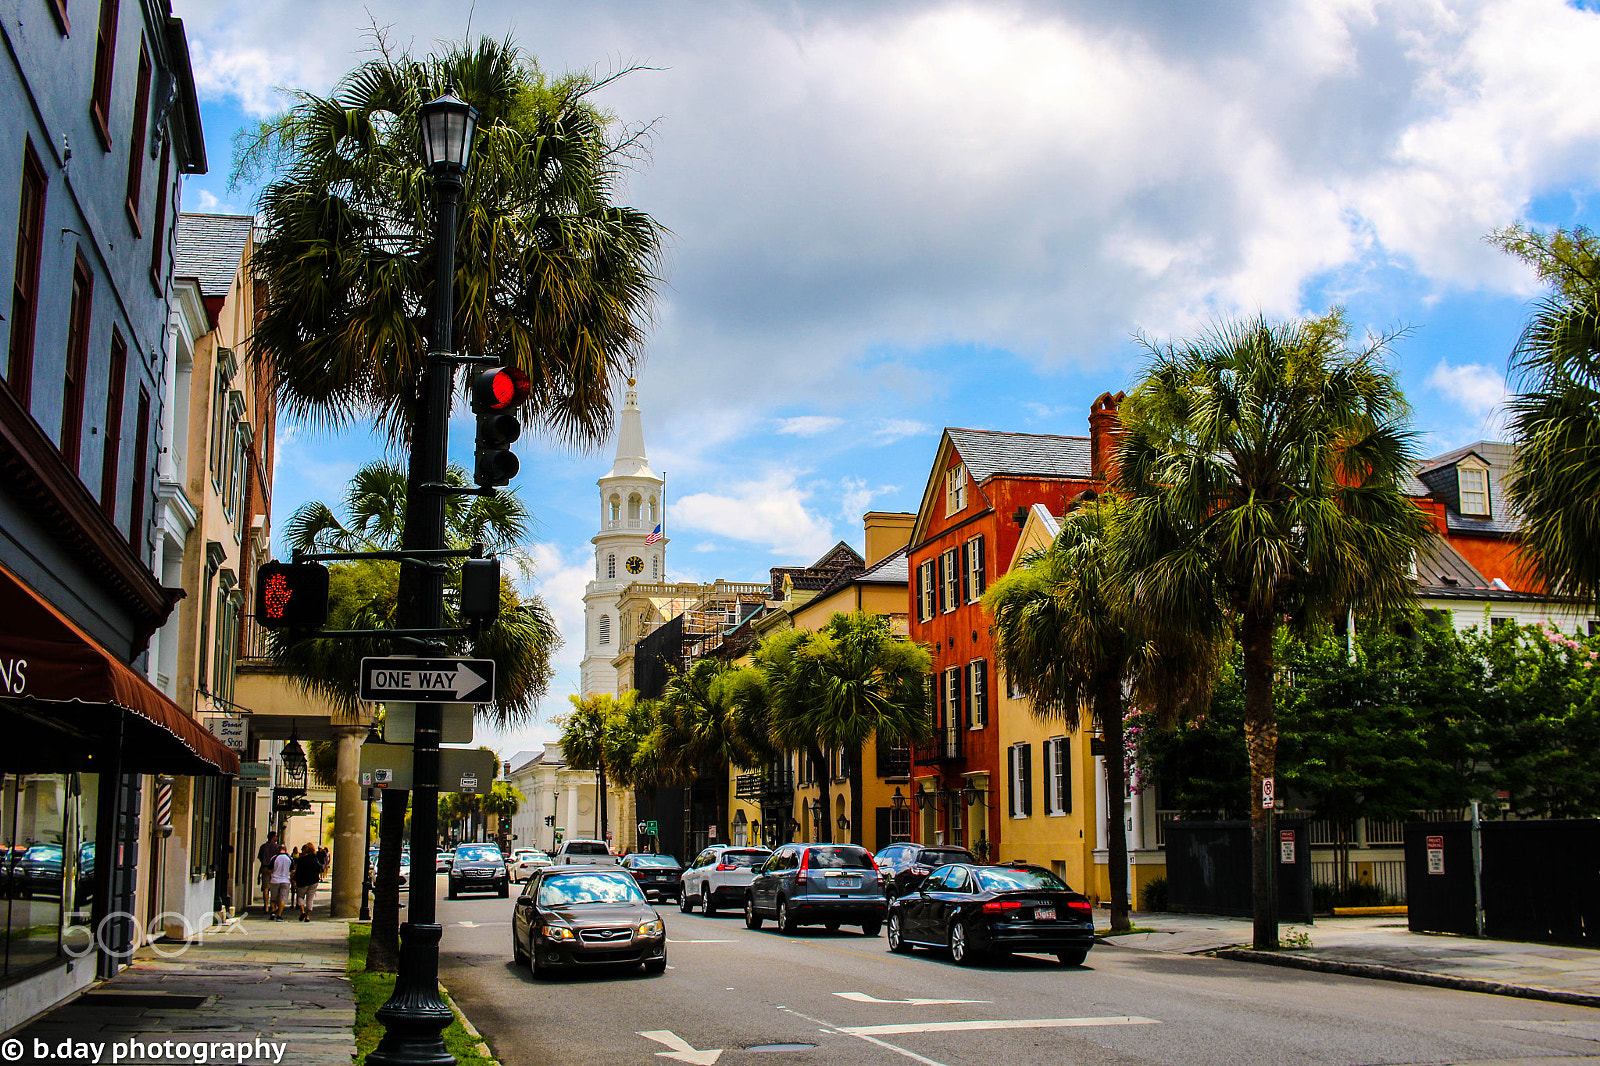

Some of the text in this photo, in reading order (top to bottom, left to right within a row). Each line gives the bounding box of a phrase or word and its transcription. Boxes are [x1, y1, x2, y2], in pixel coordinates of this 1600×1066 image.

[375, 671, 457, 689] ONE WAY
[222, 720, 243, 728] Broad
[220, 728, 243, 736] Street
[227, 737, 243, 748] Shop
